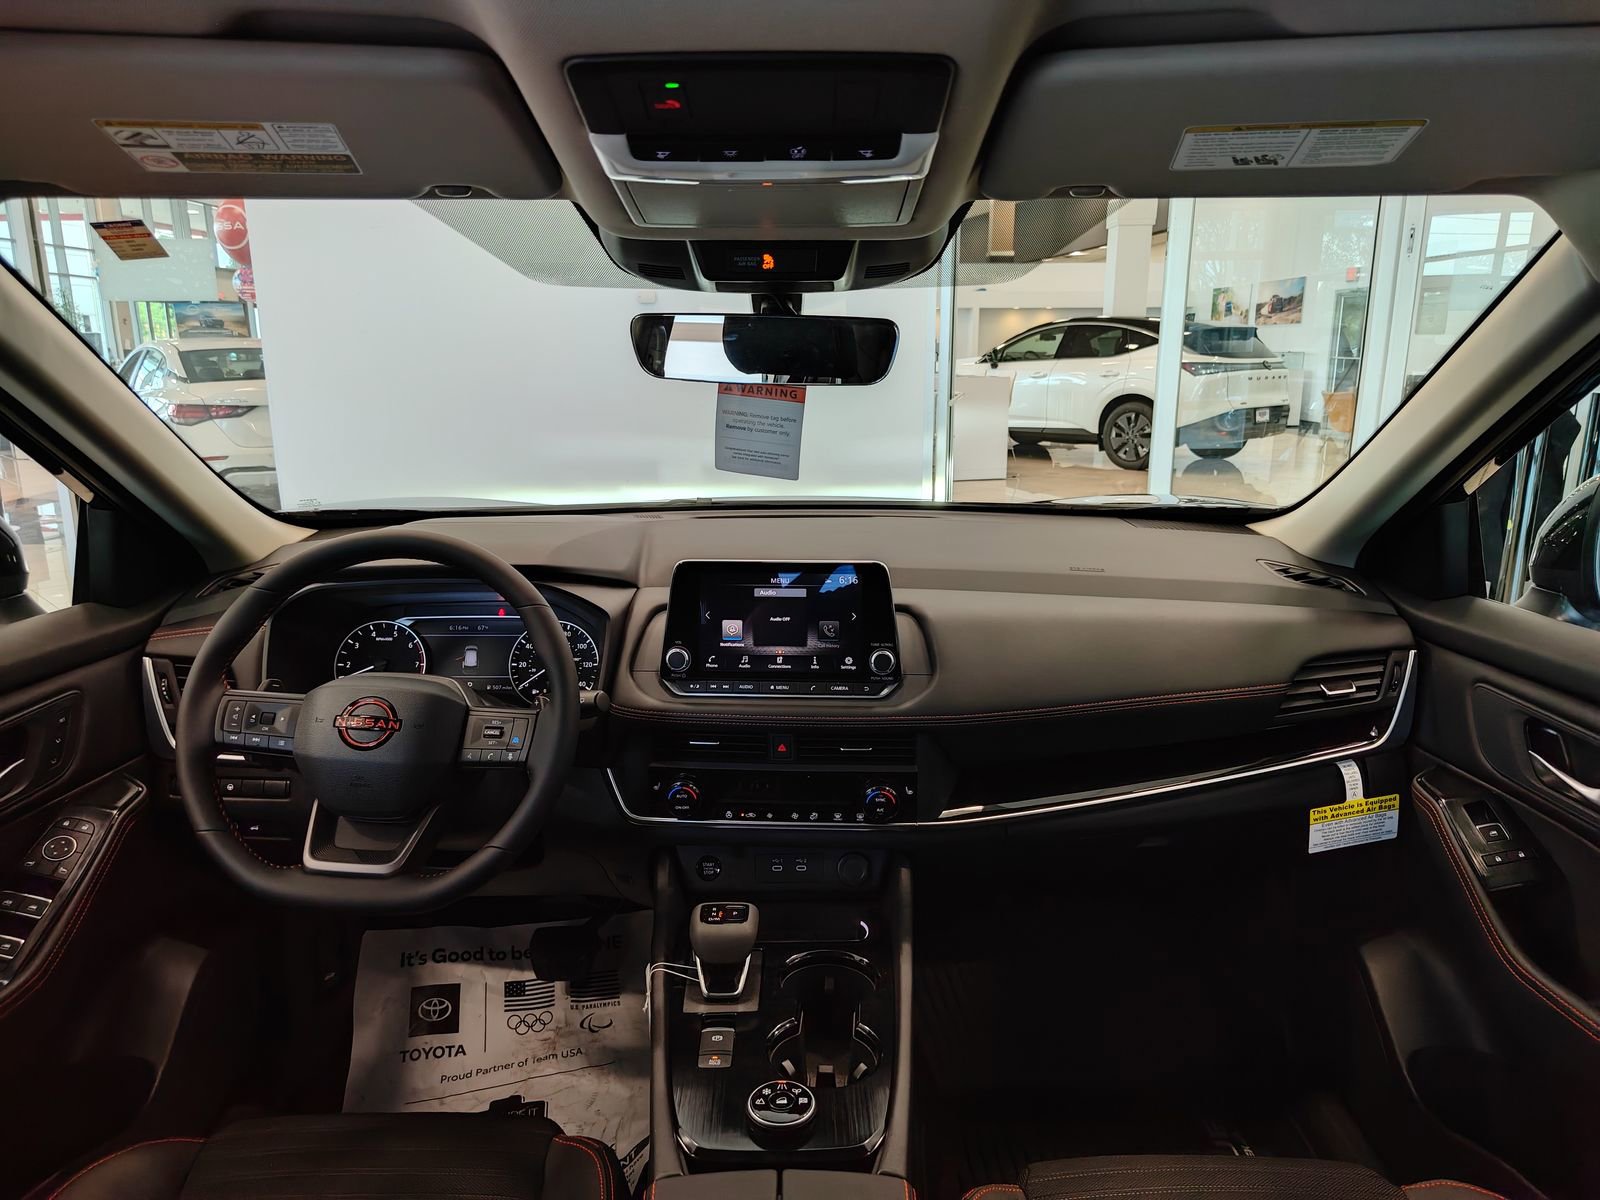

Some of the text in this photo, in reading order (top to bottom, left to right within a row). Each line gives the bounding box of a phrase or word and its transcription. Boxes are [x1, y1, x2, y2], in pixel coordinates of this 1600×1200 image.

[736, 384, 798, 399] WARNING
[838, 576, 859, 584] 6:16
[338, 717, 400, 730] NISSAN
[1329, 804, 1355, 813] Vehicle
[1365, 796, 1397, 807] Equipped
[1330, 809, 1365, 819] Advanced
[1378, 804, 1396, 812] Bags
[400, 944, 533, 968] It's Good to be
[581, 1000, 621, 1010] PARALYMPICS
[399, 1044, 467, 1063] TOYOTA
[440, 1047, 584, 1084] Proud Partner of Team USA
